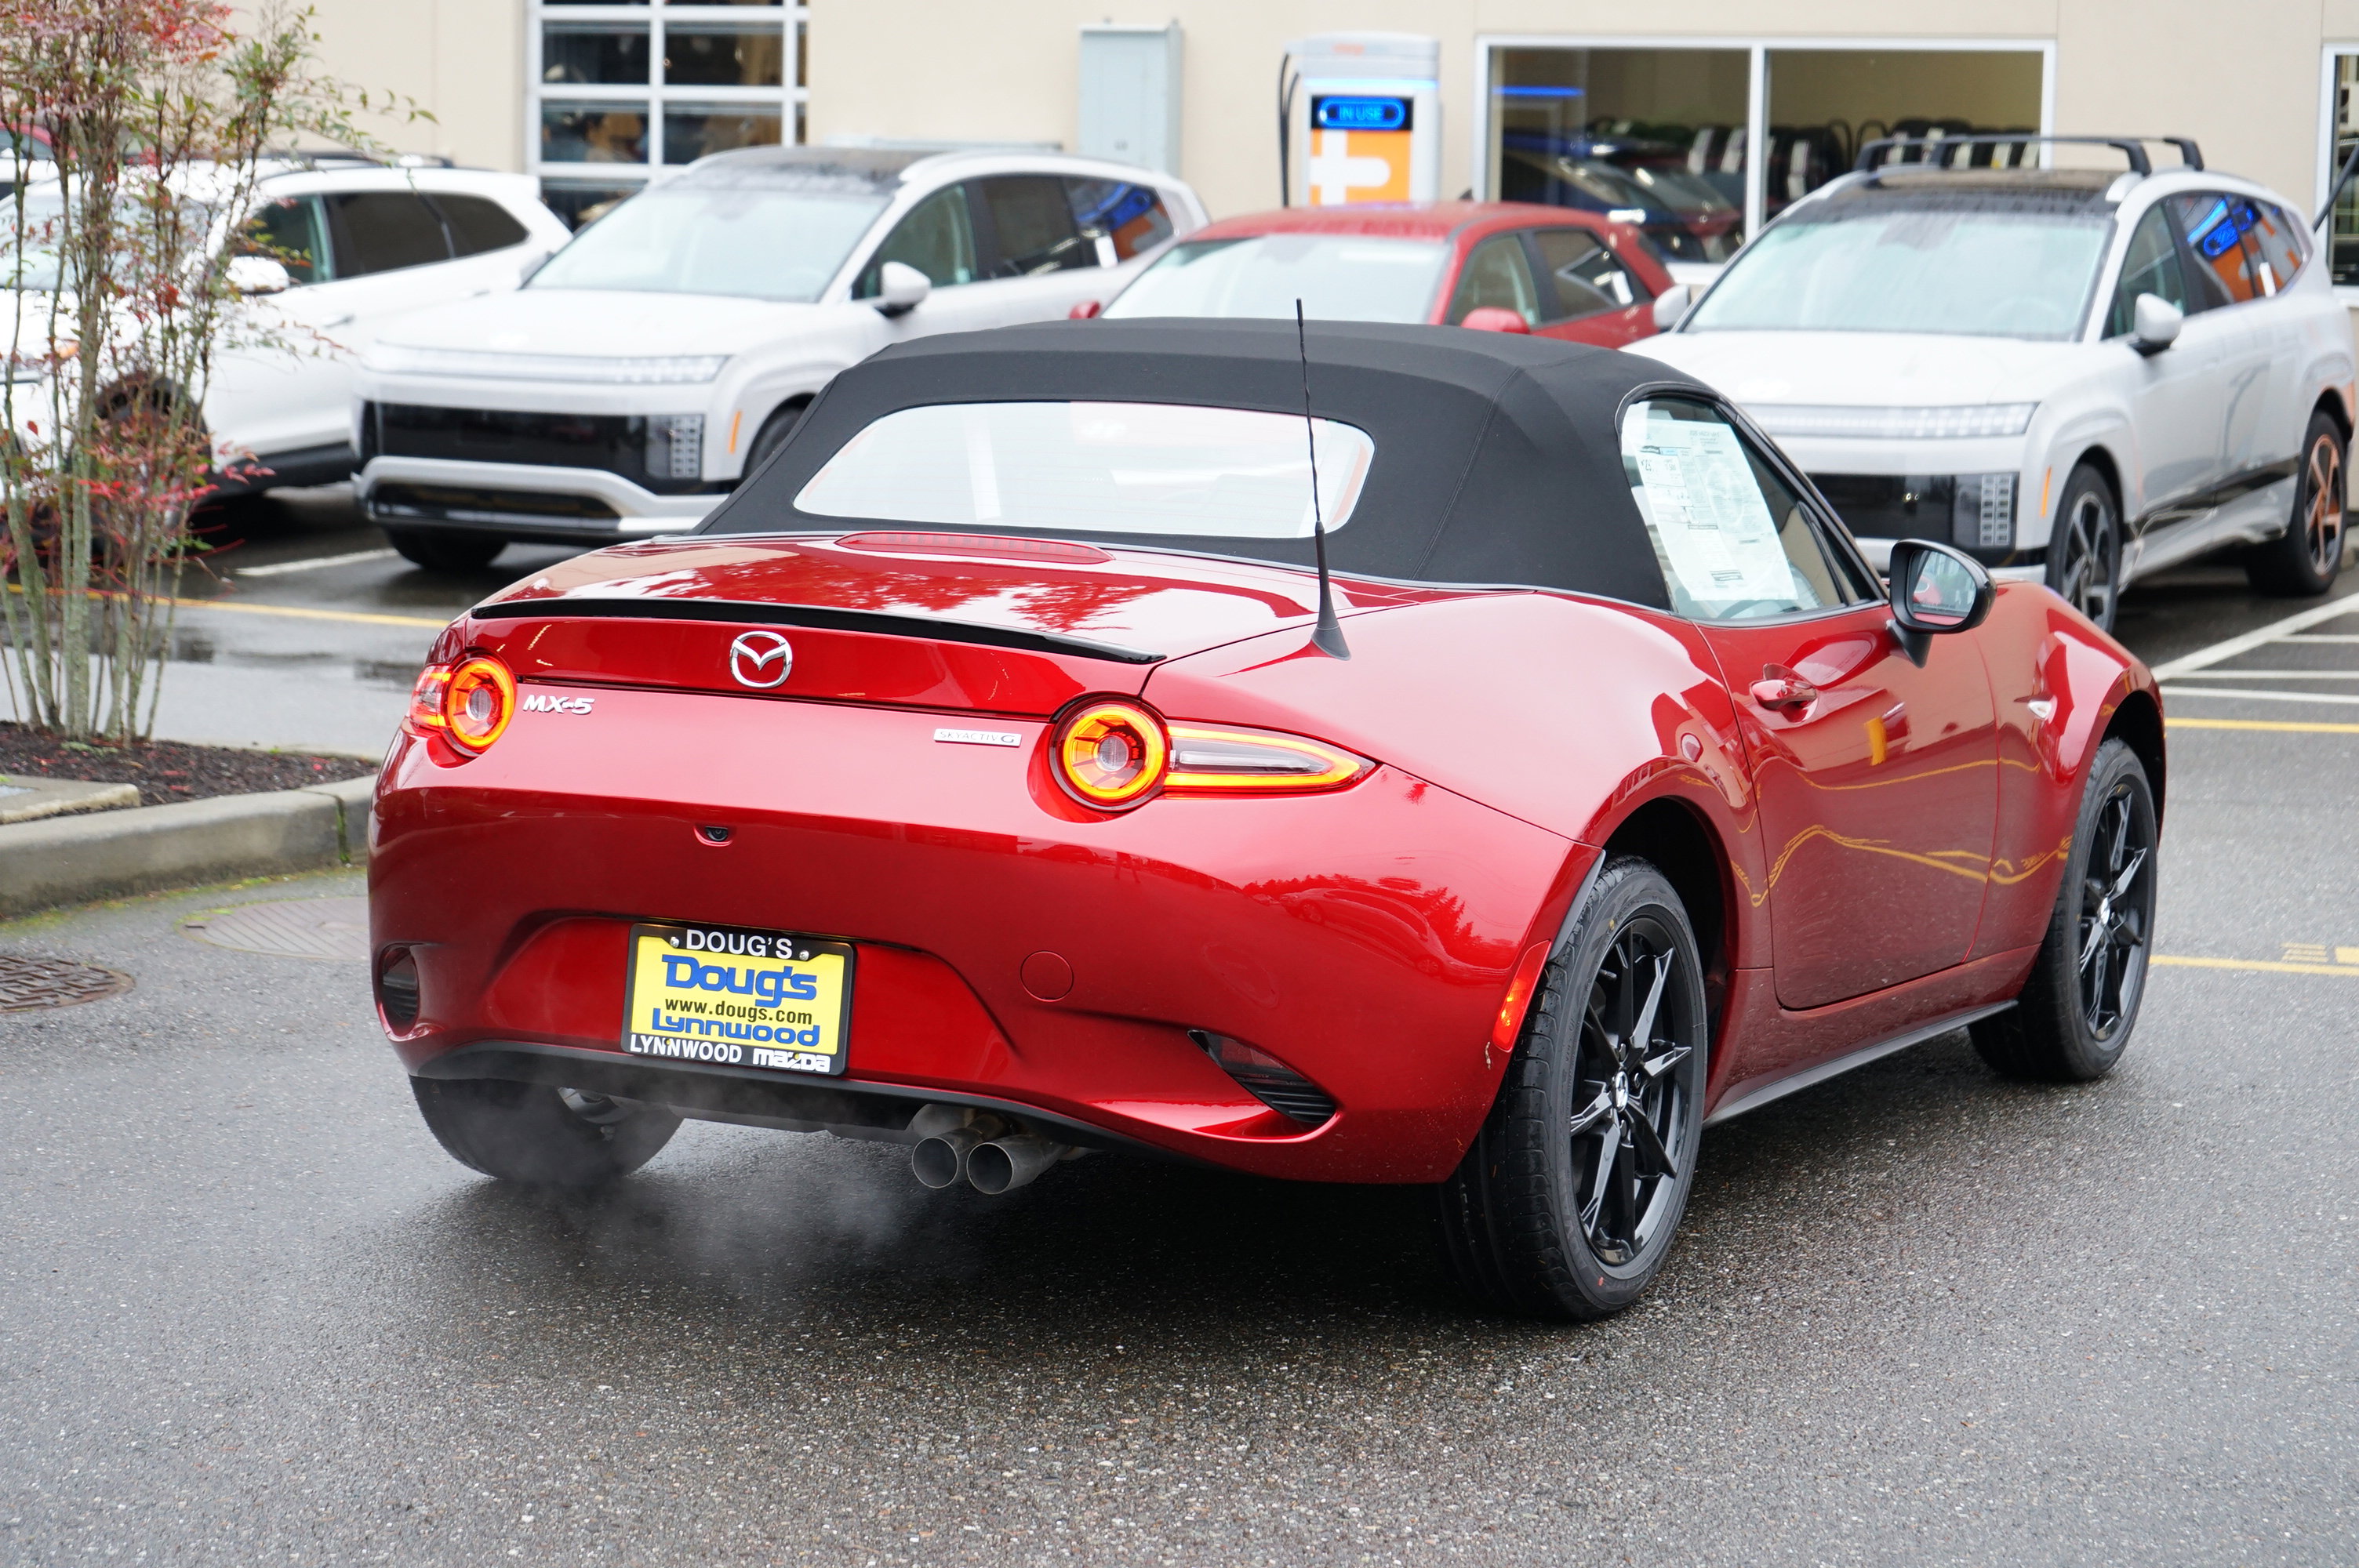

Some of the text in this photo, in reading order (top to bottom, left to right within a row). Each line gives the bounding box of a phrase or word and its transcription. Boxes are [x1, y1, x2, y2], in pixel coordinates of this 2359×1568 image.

[1339, 106, 1383, 121] IN USE
[522, 694, 596, 715] MX-5
[940, 731, 999, 742] SKYACTIV
[685, 929, 793, 960] DOUG'S
[661, 954, 817, 1008] Doug's
[665, 998, 812, 1025] www.dougs.com
[652, 1007, 820, 1047] Lynnwood
[630, 1033, 743, 1063] LYNNWOOD
